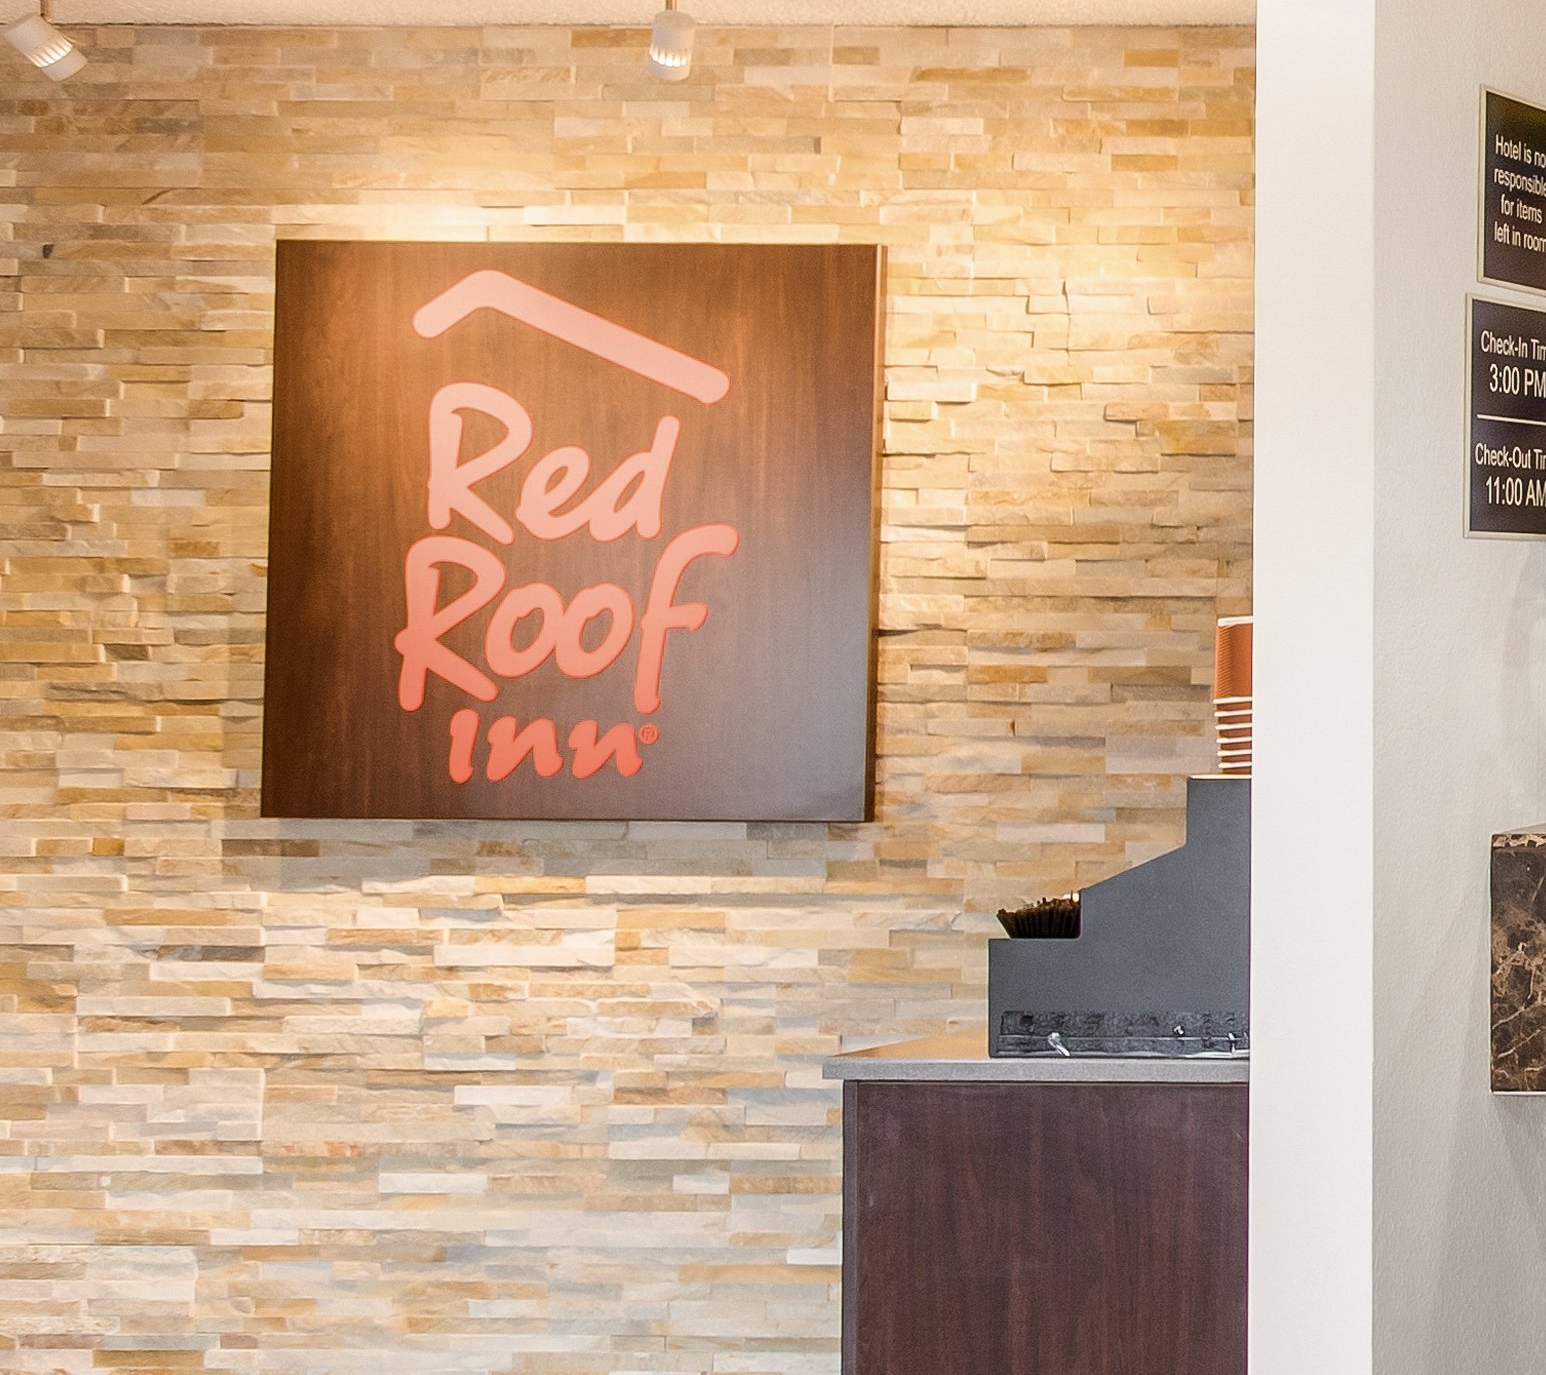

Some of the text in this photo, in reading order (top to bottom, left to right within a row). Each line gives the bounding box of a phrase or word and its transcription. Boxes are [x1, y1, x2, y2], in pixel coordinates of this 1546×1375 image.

[1495, 134, 1521, 161] Hotel
[1523, 143, 1532, 164] is
[1500, 193, 1543, 224] for items
[1494, 221, 1510, 244] left
[1512, 225, 1521, 246] in
[1481, 330, 1528, 359] Check-In
[1489, 363, 1546, 398] 3:00 PM
[428, 381, 681, 545] Red
[1475, 442, 1532, 469] Check-Out
[1485, 476, 1523, 506] 11:00
[394, 524, 740, 714] Roof
